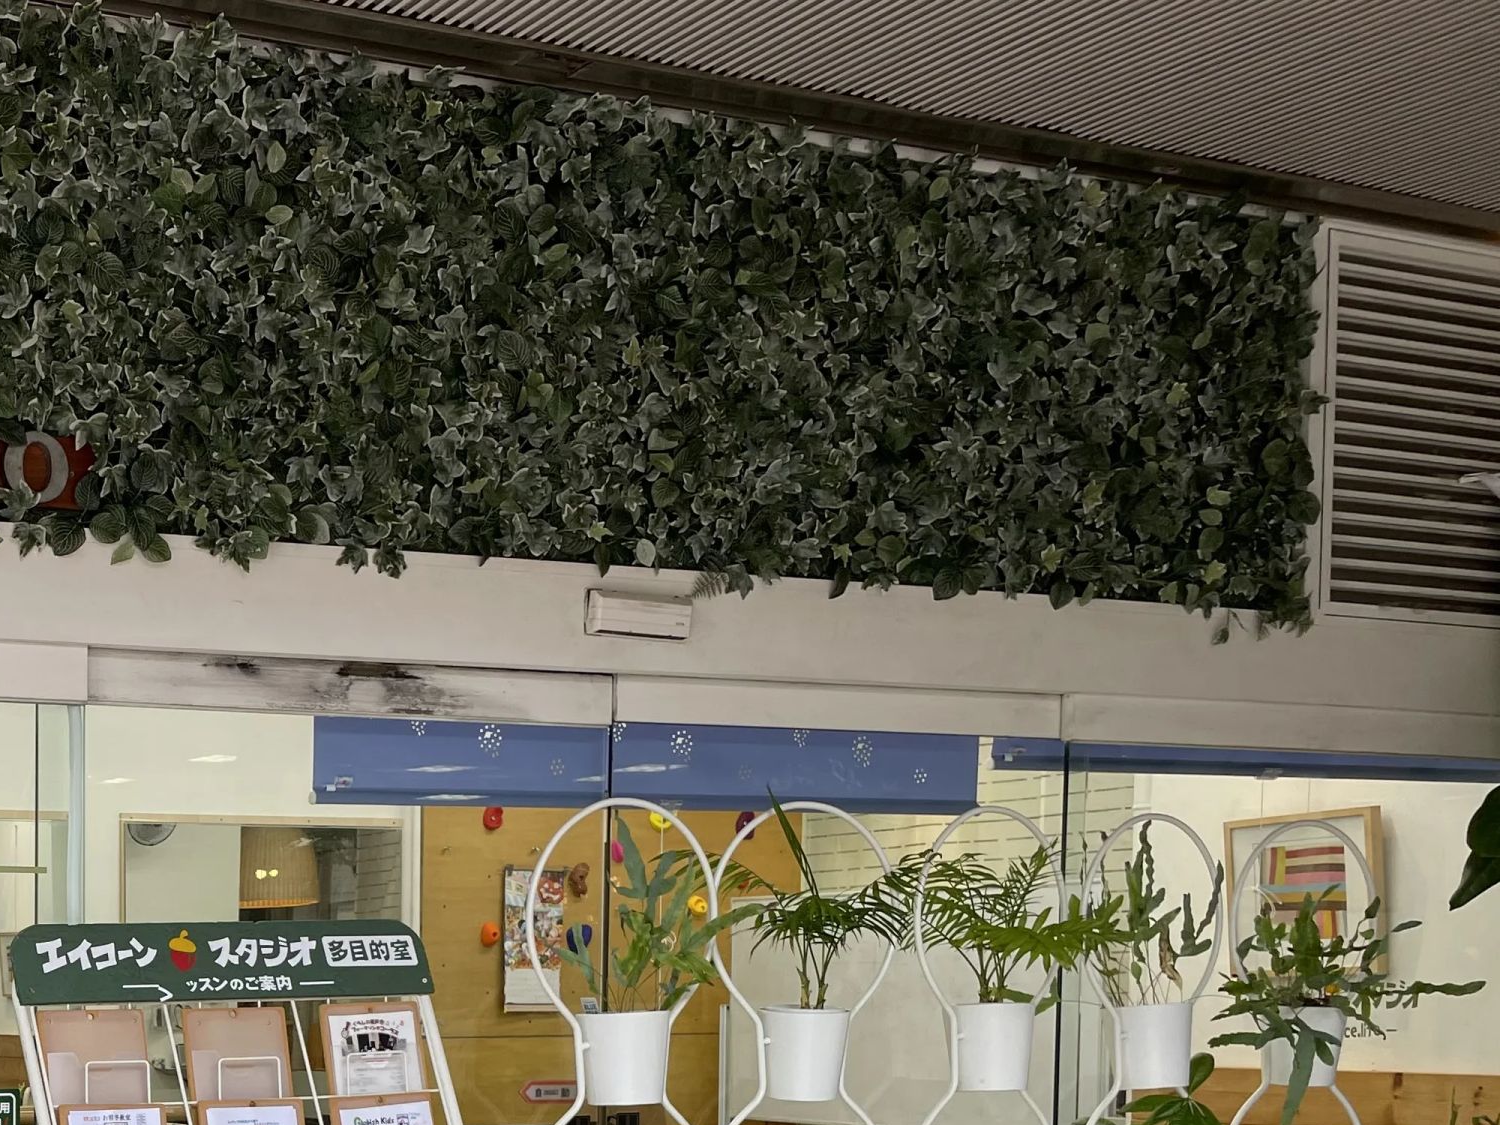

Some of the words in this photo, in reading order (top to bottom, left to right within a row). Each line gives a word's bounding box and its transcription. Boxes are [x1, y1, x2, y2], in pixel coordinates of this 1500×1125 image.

[35, 936, 157, 974] エイコーン
[207, 934, 319, 968] スタジオ
[326, 937, 414, 964] 多目的室
